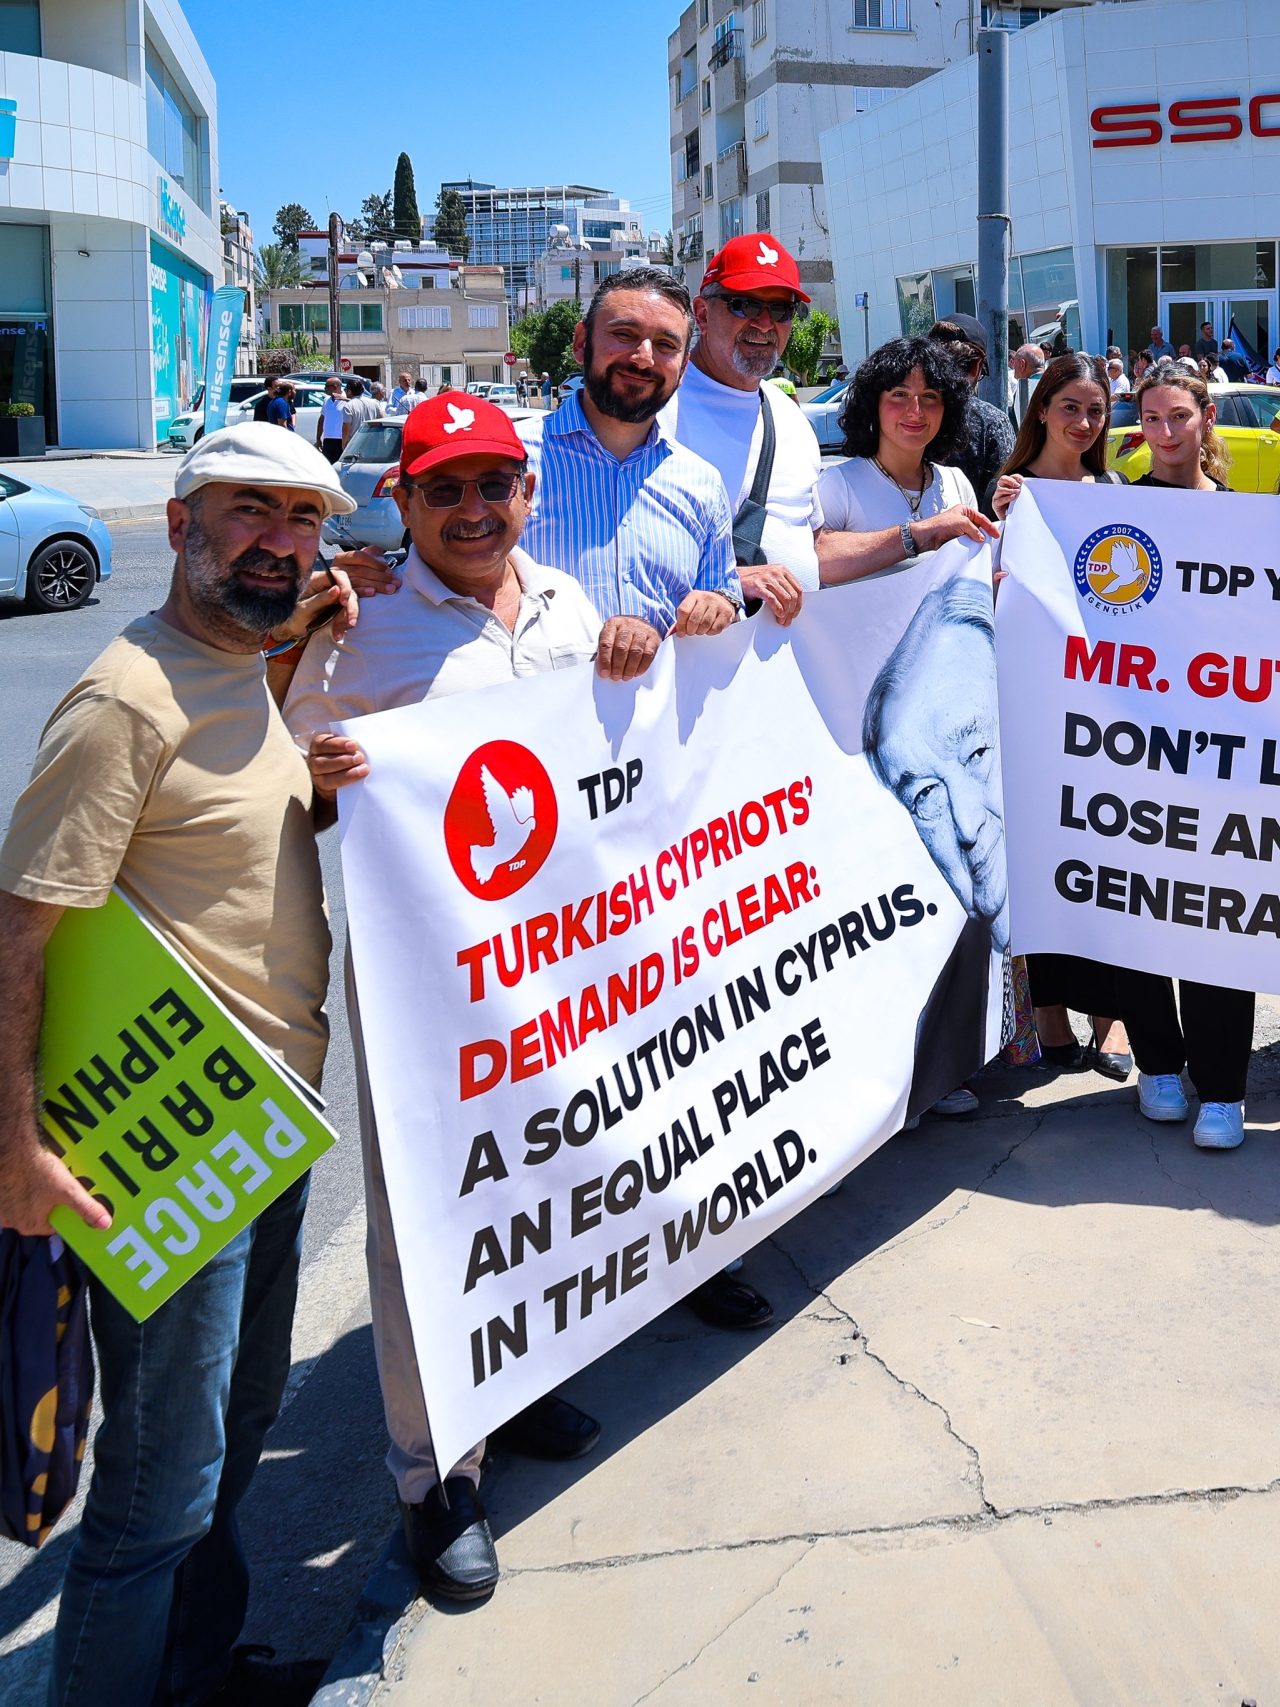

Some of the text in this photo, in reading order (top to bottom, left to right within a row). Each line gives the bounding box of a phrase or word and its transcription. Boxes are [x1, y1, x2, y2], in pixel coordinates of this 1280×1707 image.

[210, 311, 233, 412] Hisense
[1111, 526, 1133, 535] 2007
[1088, 563, 1108, 573] TDP
[1175, 560, 1255, 597] TDP
[1087, 595, 1143, 617] GENÇLİK
[1063, 634, 1170, 693] MR.
[1063, 711, 1246, 780] DON’T
[577, 757, 643, 820] TDP
[1059, 784, 1200, 852] LOSE
[456, 775, 813, 1003] TURKISH CYPRIOTS’
[508, 859, 527, 871] TDP
[459, 861, 821, 1102] DEMAND IS CLEAR:
[43, 987, 205, 1159] ΕΙΡΗΝ
[458, 883, 938, 1198] A SOLUTION IN CYPRUS.
[463, 1017, 832, 1295] AN EQUAL PLACE
[106, 1096, 308, 1292] PEACE
[470, 1129, 817, 1389] IN THE WORLD.
